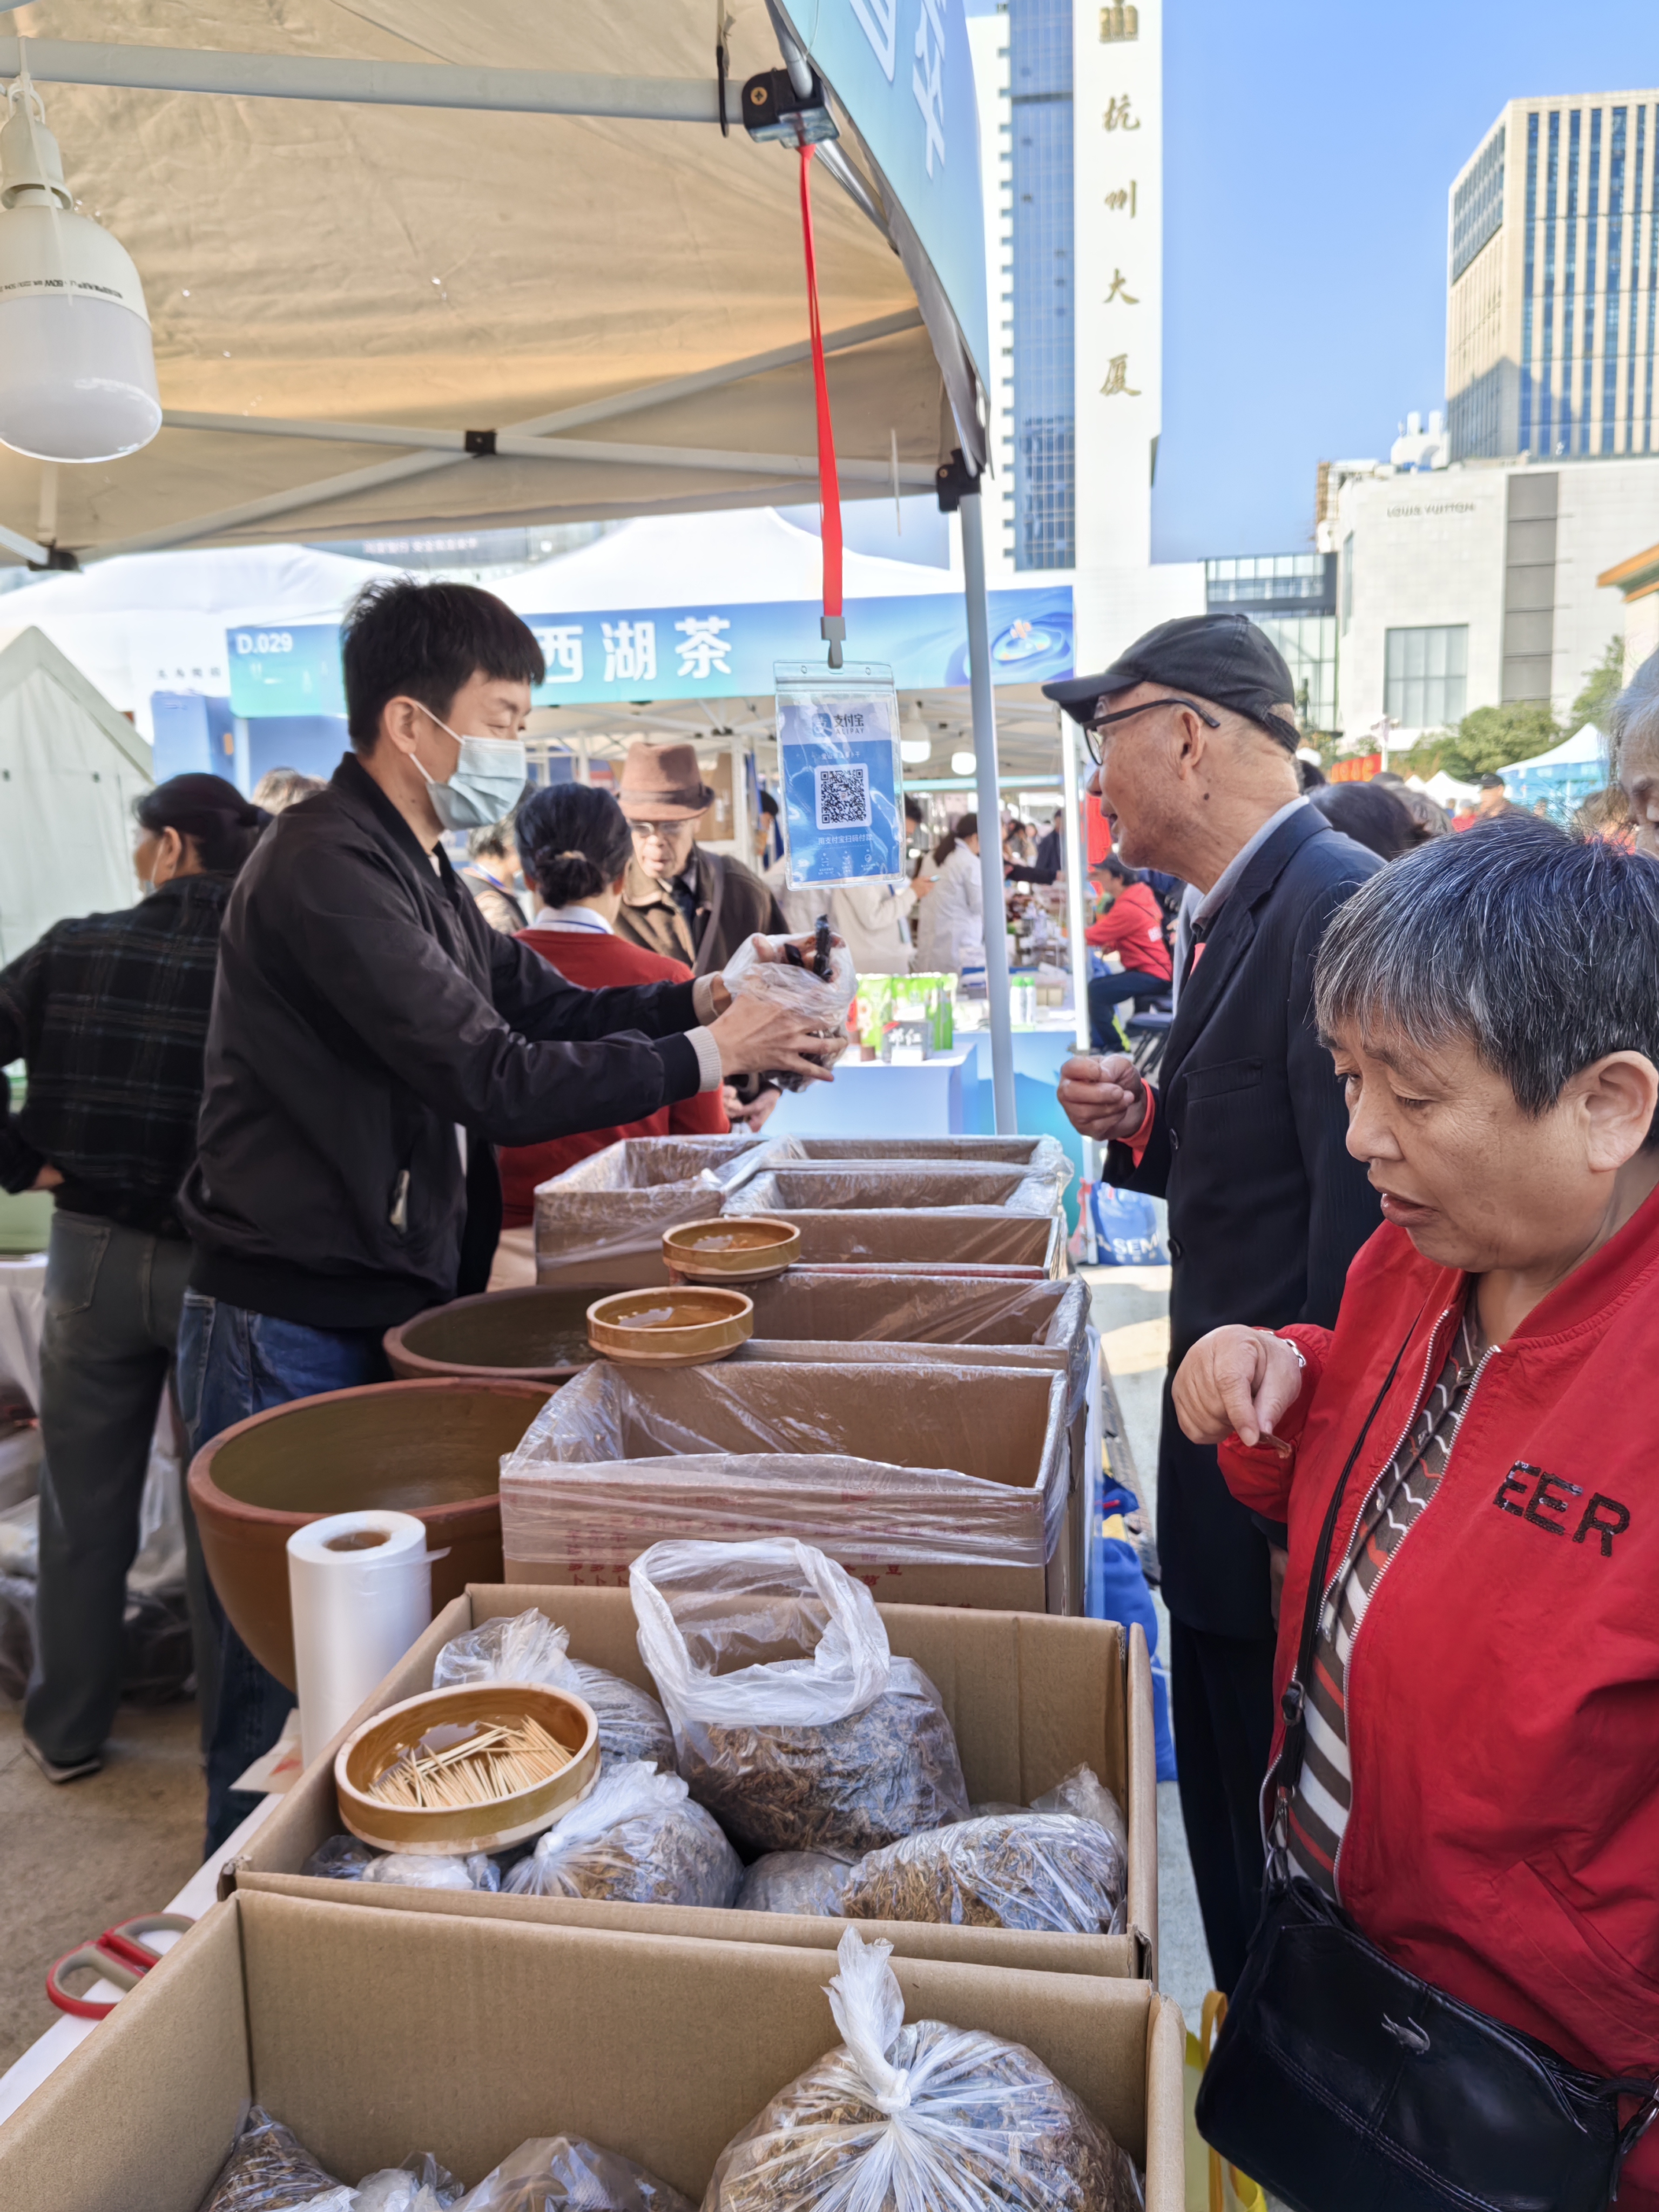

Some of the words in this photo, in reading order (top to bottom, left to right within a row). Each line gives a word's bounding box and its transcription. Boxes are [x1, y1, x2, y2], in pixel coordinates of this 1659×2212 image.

[1100, 94, 1142, 397] 杭州大厦
[1386, 505, 1421, 517] LOUIS
[236, 632, 293, 655] D.029
[532, 616, 732, 684] 西湖茶
[834, 713, 864, 728] 支付宝
[818, 833, 873, 845] 用支付宝扫码付款
[1493, 1460, 1630, 1557] EER
